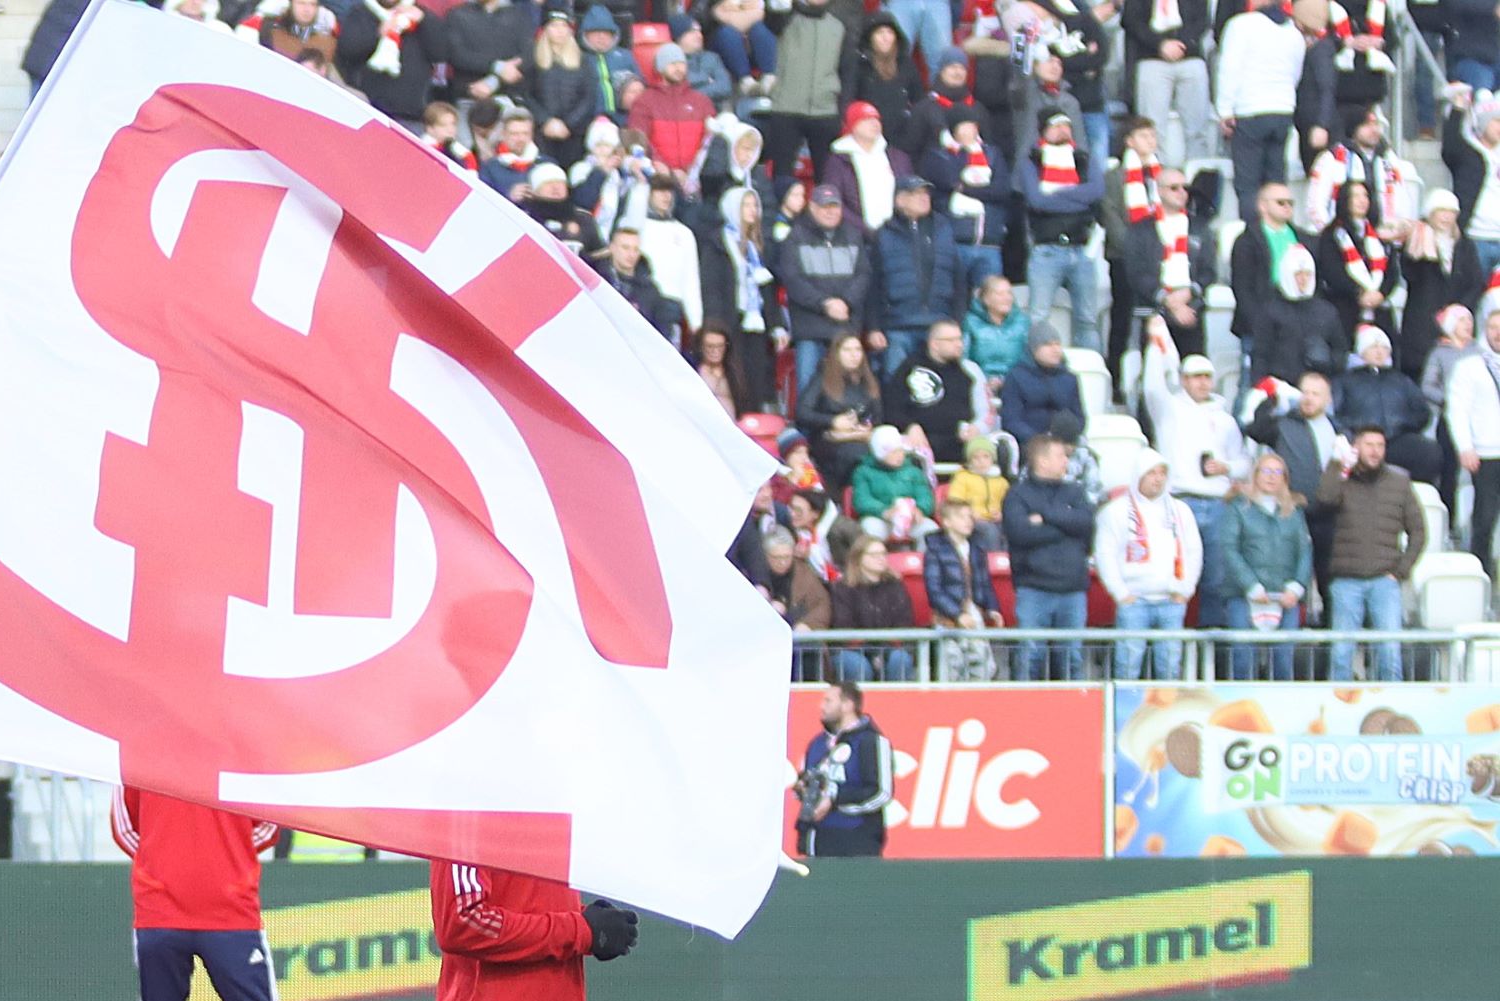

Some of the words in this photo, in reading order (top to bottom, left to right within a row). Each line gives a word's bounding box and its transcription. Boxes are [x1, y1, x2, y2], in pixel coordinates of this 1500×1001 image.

[1290, 742, 1461, 783] PROTEIN
[1226, 772, 1281, 801] ON
[1399, 774, 1465, 804] CRISP
[1006, 899, 1273, 986] Kramel
